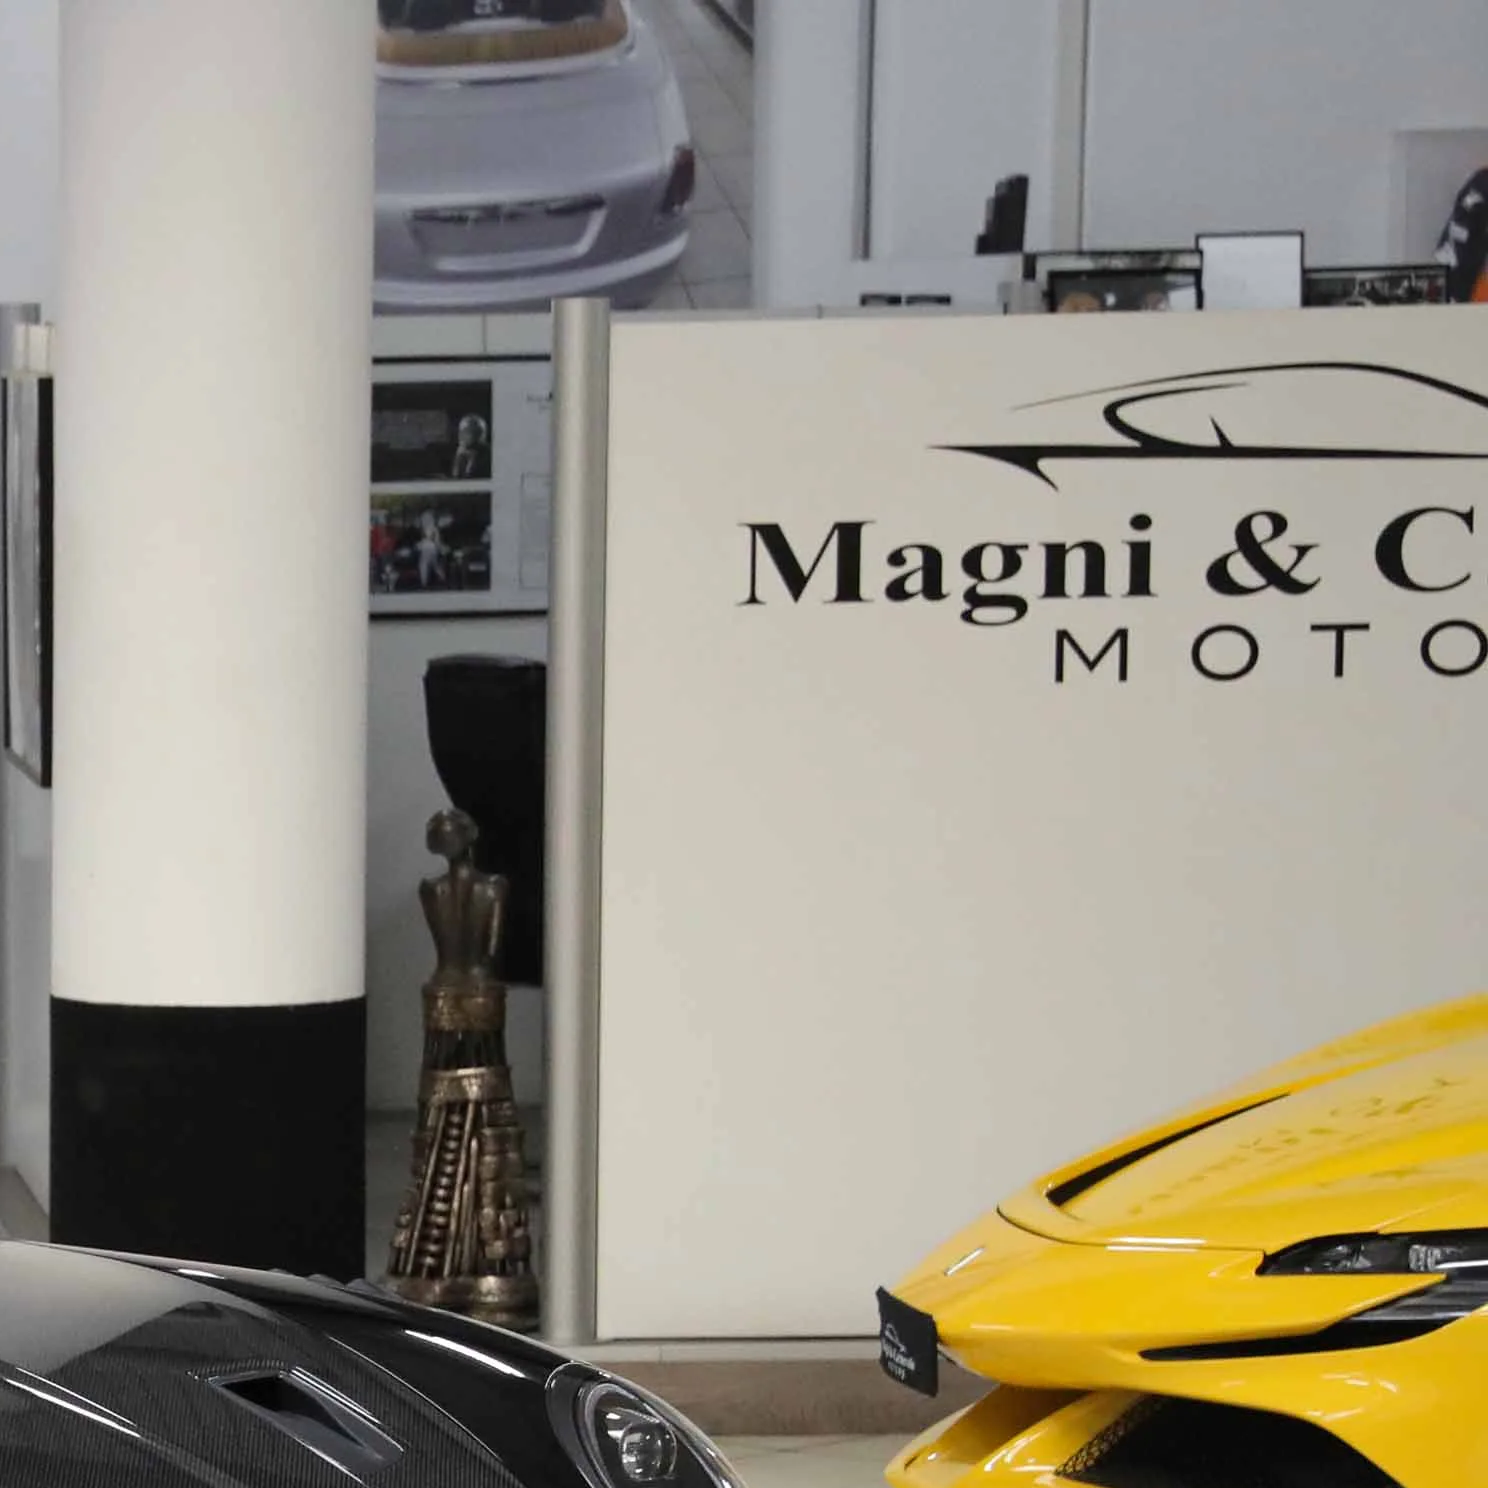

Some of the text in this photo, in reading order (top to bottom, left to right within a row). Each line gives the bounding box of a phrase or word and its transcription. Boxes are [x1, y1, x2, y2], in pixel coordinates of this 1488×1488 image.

[737, 512, 1157, 627] Magni
[1205, 509, 1321, 597] &
[1054, 618, 1488, 684] MOTO
